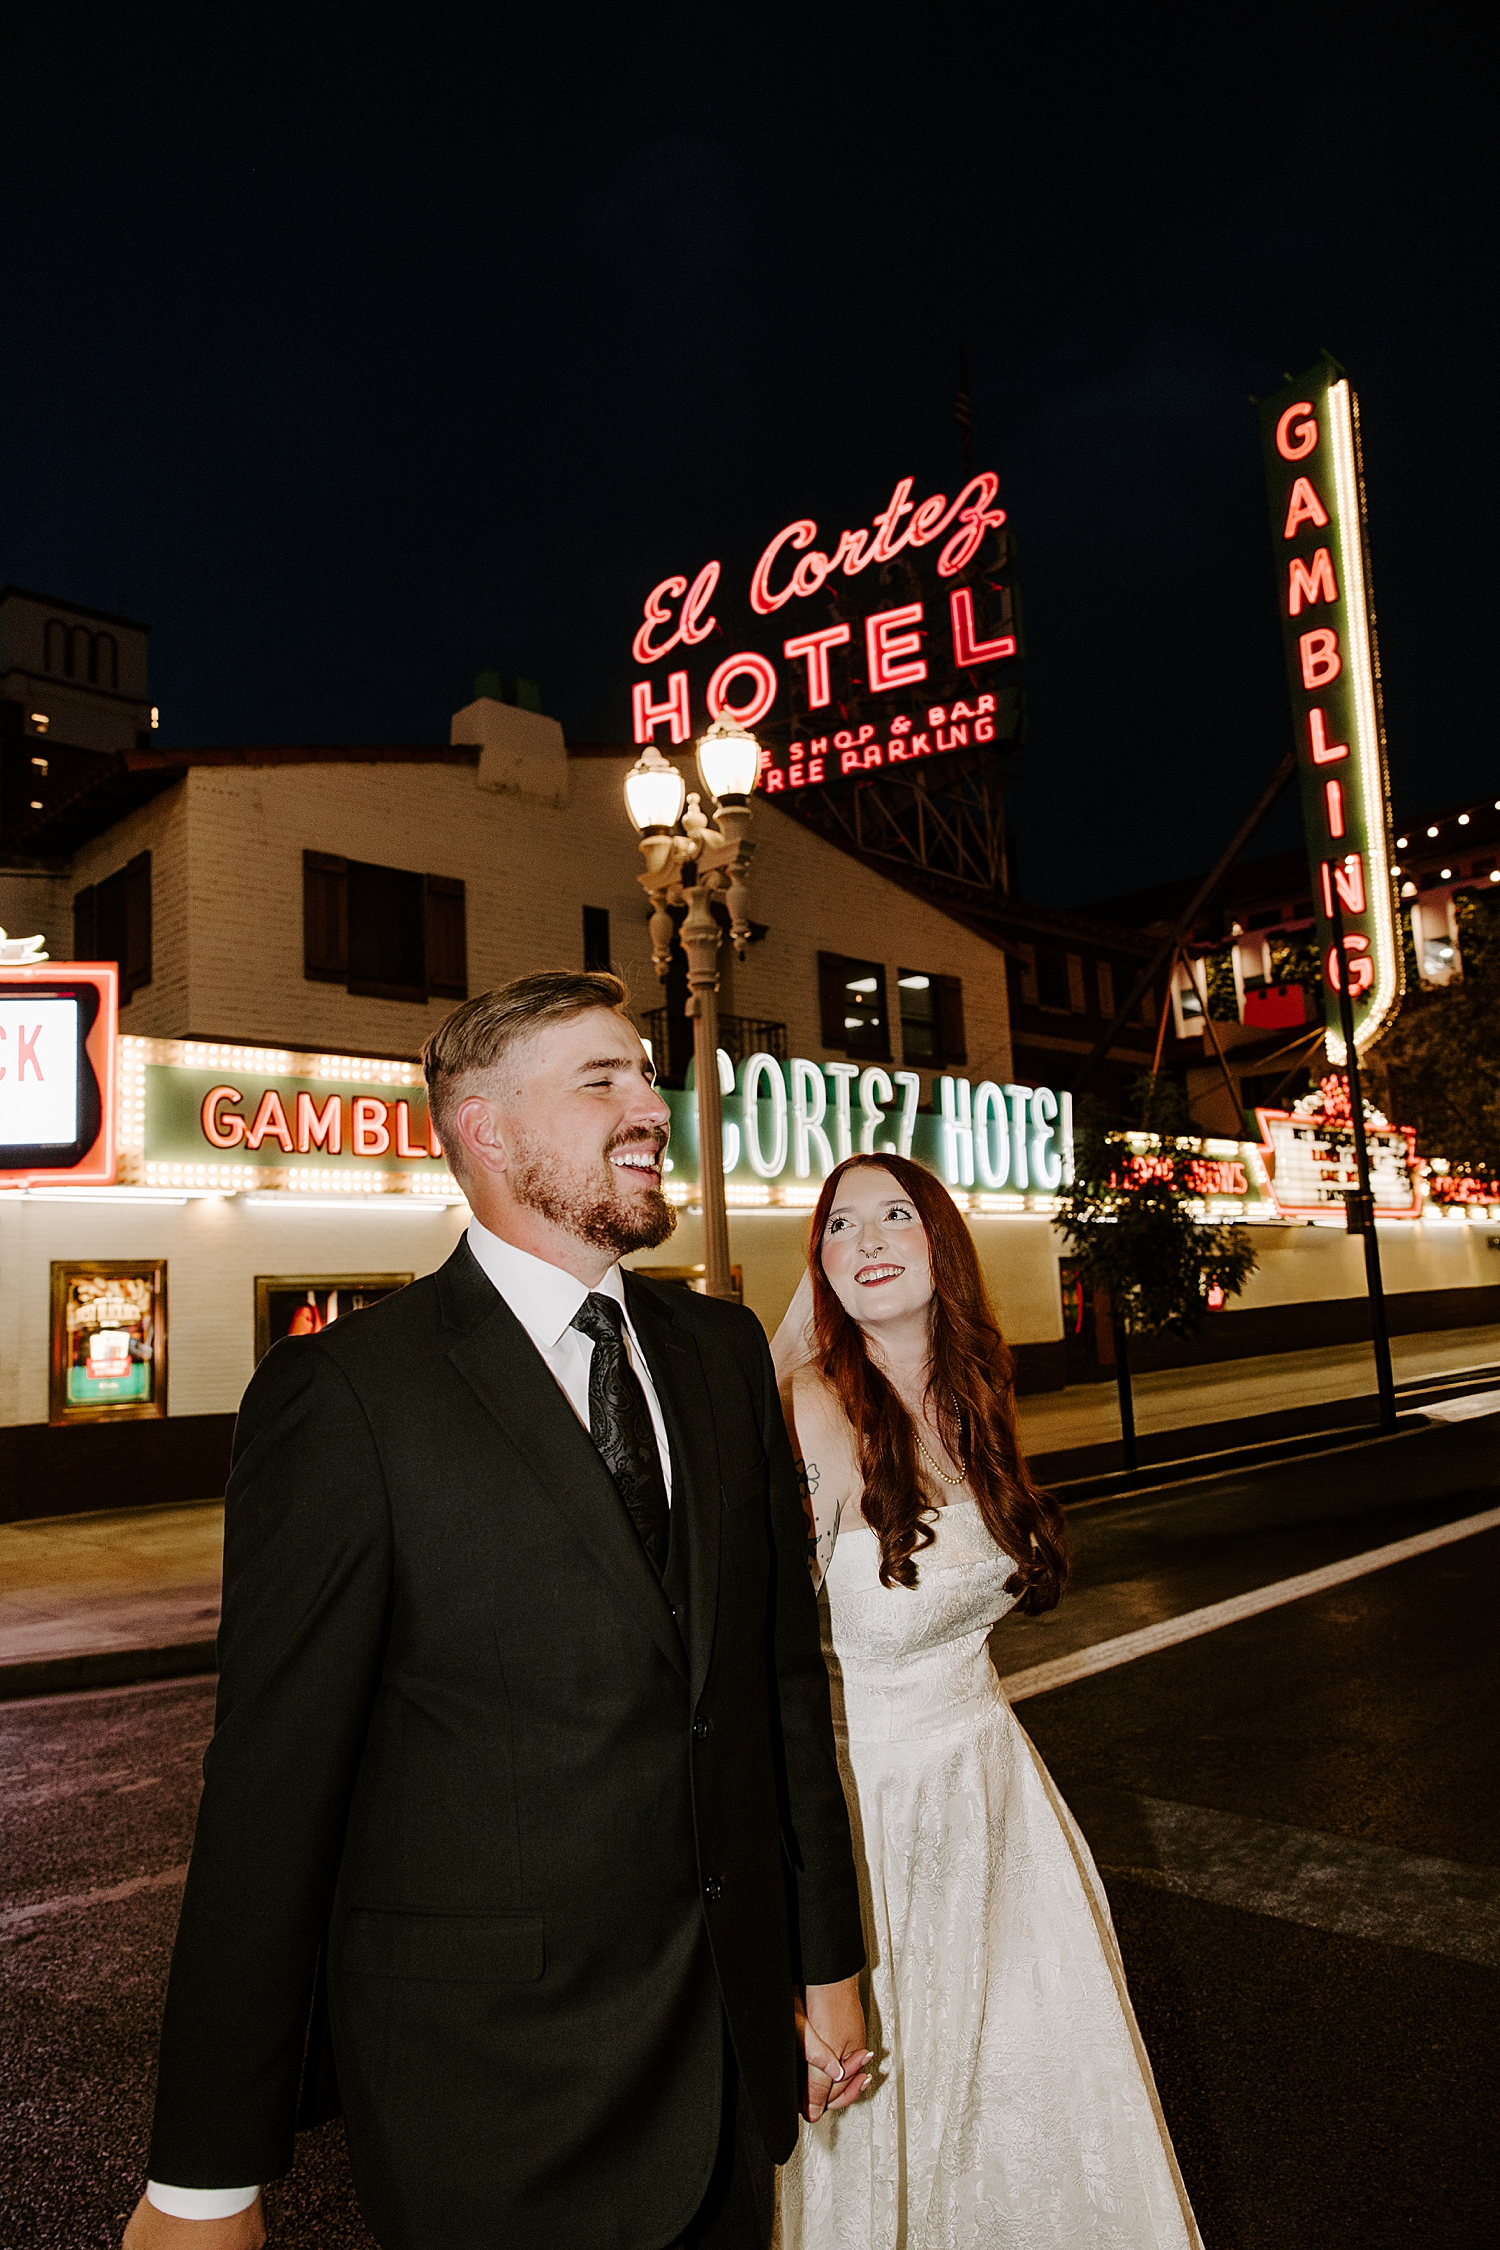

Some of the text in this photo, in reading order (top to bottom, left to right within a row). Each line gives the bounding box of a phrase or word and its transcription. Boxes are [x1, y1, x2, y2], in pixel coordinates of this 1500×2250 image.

[632, 471, 1007, 664] El Cortez
[632, 587, 1017, 744] HOTEL
[789, 723, 875, 762] SHOP
[890, 715, 913, 735] &
[928, 694, 997, 727] BAR
[1275, 401, 1374, 997] GAMBLING
[757, 716, 995, 793] REE PARKING
